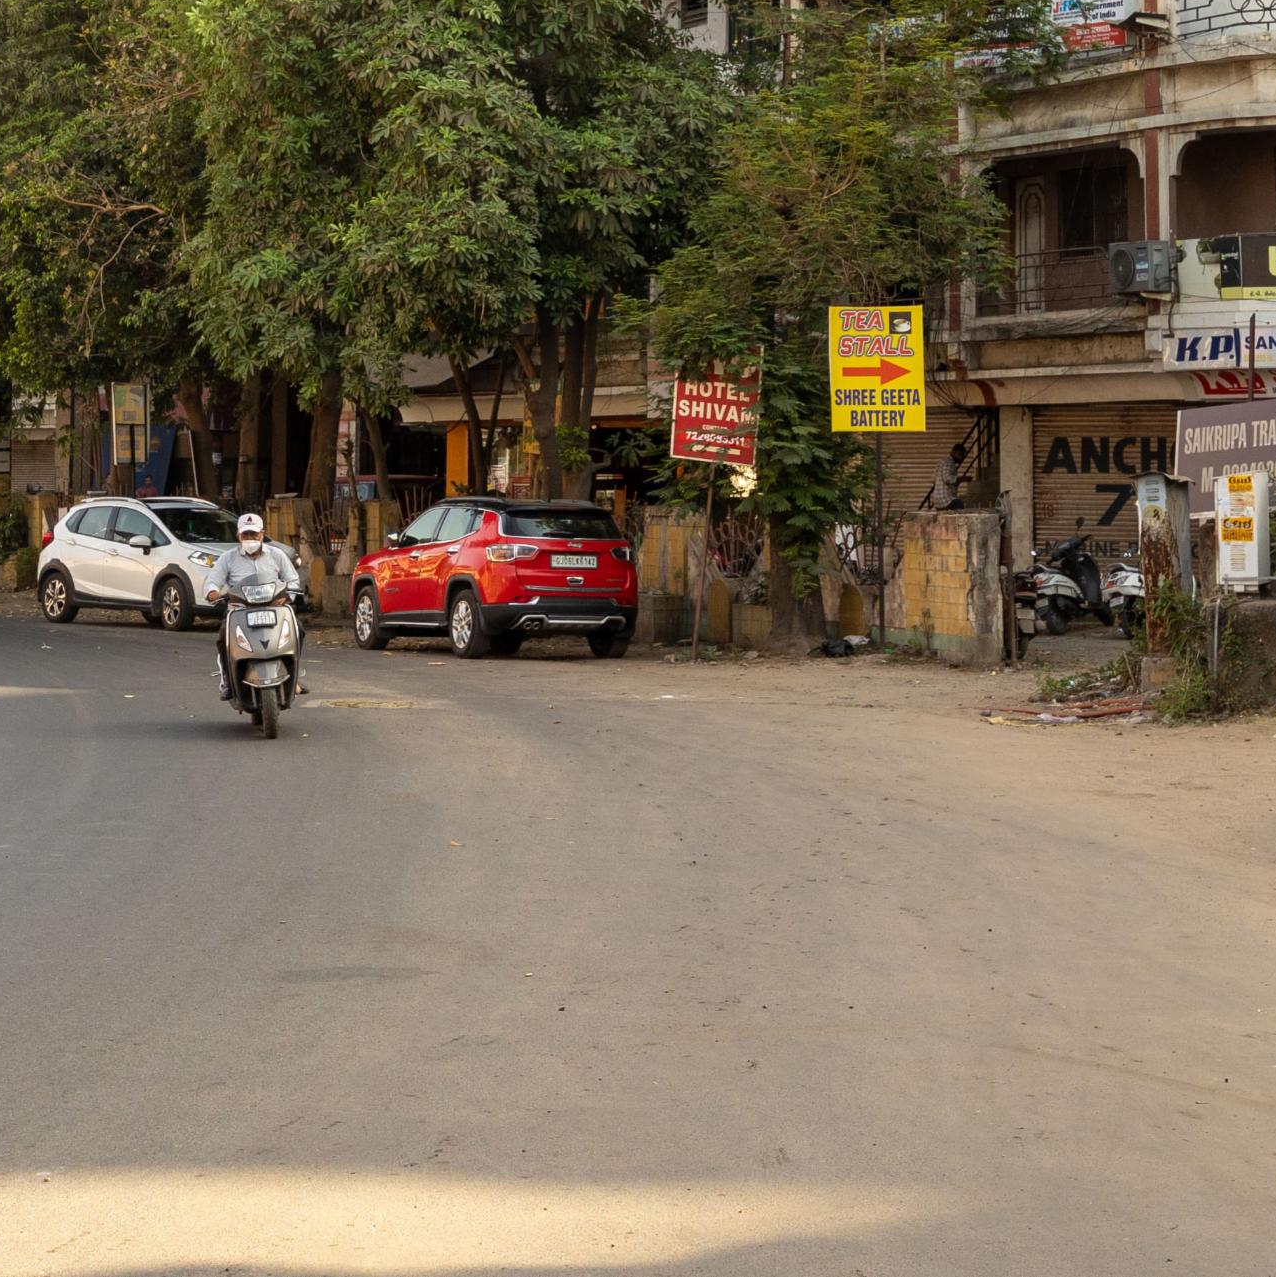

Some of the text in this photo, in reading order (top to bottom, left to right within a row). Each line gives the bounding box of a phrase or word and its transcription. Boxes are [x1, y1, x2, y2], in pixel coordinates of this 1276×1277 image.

[840, 309, 884, 331] TEA
[838, 335, 914, 357] STALL
[1176, 334, 1235, 362] K.P.
[834, 389, 921, 406] SHREE GEETA
[850, 410, 906, 427] BATTERY
[1184, 422, 1247, 455] SAIKRUPA
[1042, 436, 1176, 474] ANCH
[1045, 540, 1120, 557] MINE
